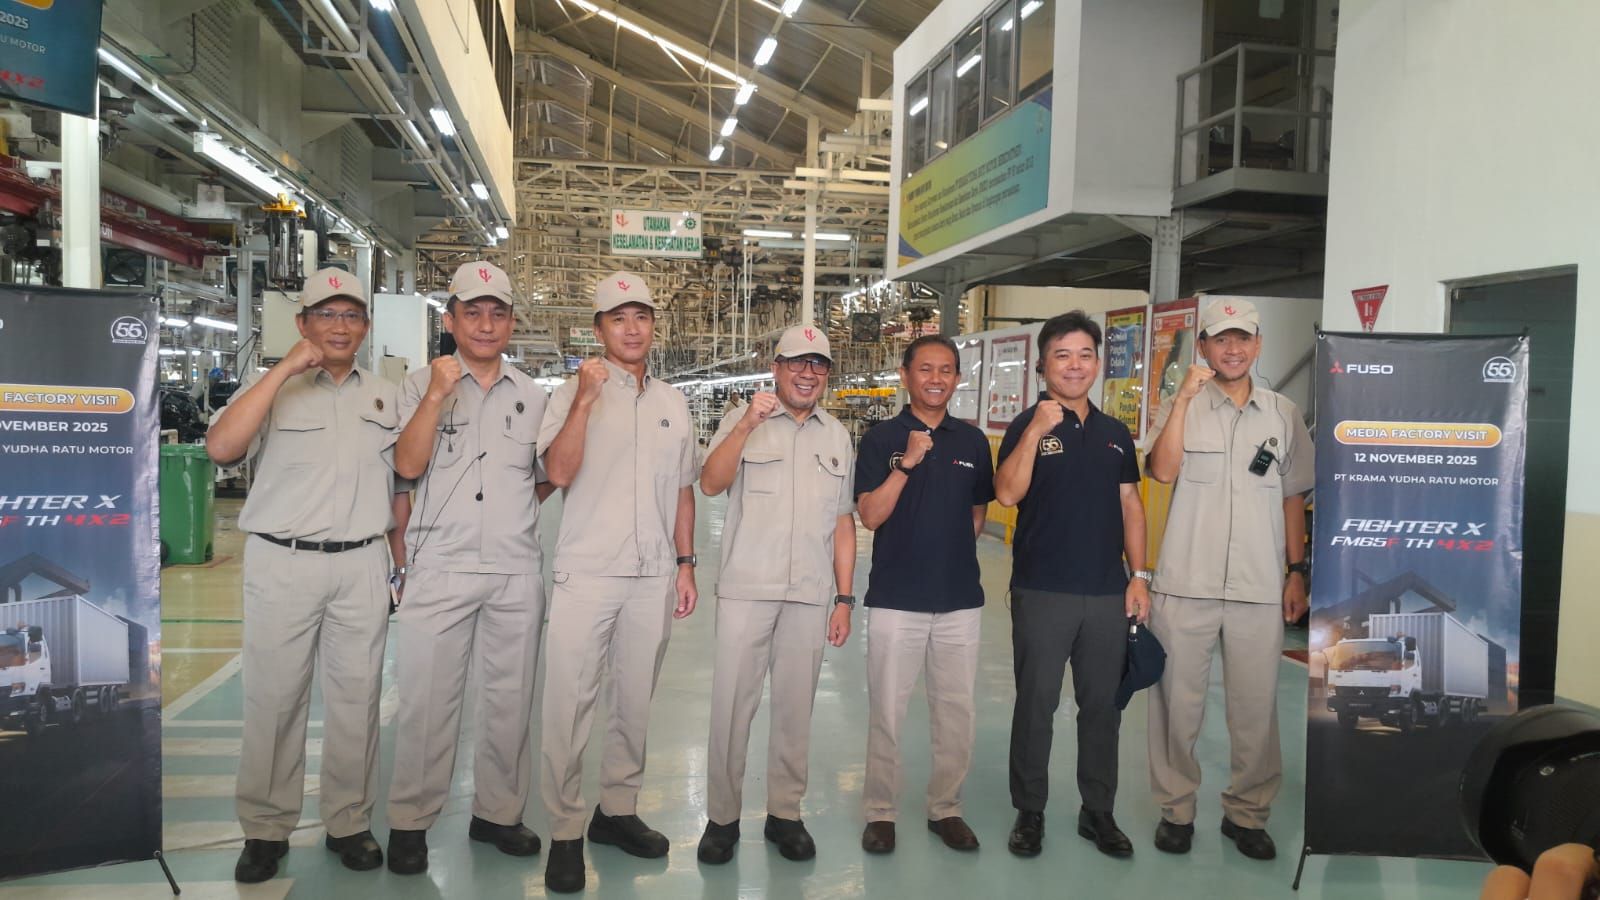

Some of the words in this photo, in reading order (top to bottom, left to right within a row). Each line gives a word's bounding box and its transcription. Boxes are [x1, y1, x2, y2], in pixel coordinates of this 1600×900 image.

[0, 11, 29, 29] 2025
[10, 37, 46, 54] MOTOR
[115, 322, 142, 337] 55
[1346, 364, 1394, 375] FUSO
[1487, 362, 1512, 377] 55
[4, 392, 77, 404] FACTORY
[80, 394, 119, 405] VISIT
[0, 420, 68, 432] VEMBER
[72, 422, 108, 433] 2025
[1346, 428, 1388, 438] MEDIA
[1391, 429, 1451, 440] FACTORY
[1455, 431, 1488, 441] VISIT
[2, 444, 49, 454] YUDHA
[52, 445, 85, 455] RATU
[89, 446, 134, 455] MOTOR
[1354, 453, 1366, 463] 12
[1369, 454, 1443, 465] NOVEMBER
[1446, 455, 1477, 466] 2025
[1349, 474, 1386, 483] KRAMA
[1389, 475, 1426, 484] YUDHA
[1429, 476, 1457, 485] RATU
[1459, 477, 1499, 486] MOTOR
[93, 494, 122, 509] X
[25, 515, 60, 527] TH
[65, 513, 131, 526] 4X2
[1342, 518, 1458, 534] FIGHTER
[1462, 522, 1487, 535] X
[1331, 535, 1400, 549] FM65F
[1405, 538, 1434, 548] TH
[1436, 539, 1494, 550] 4X2
